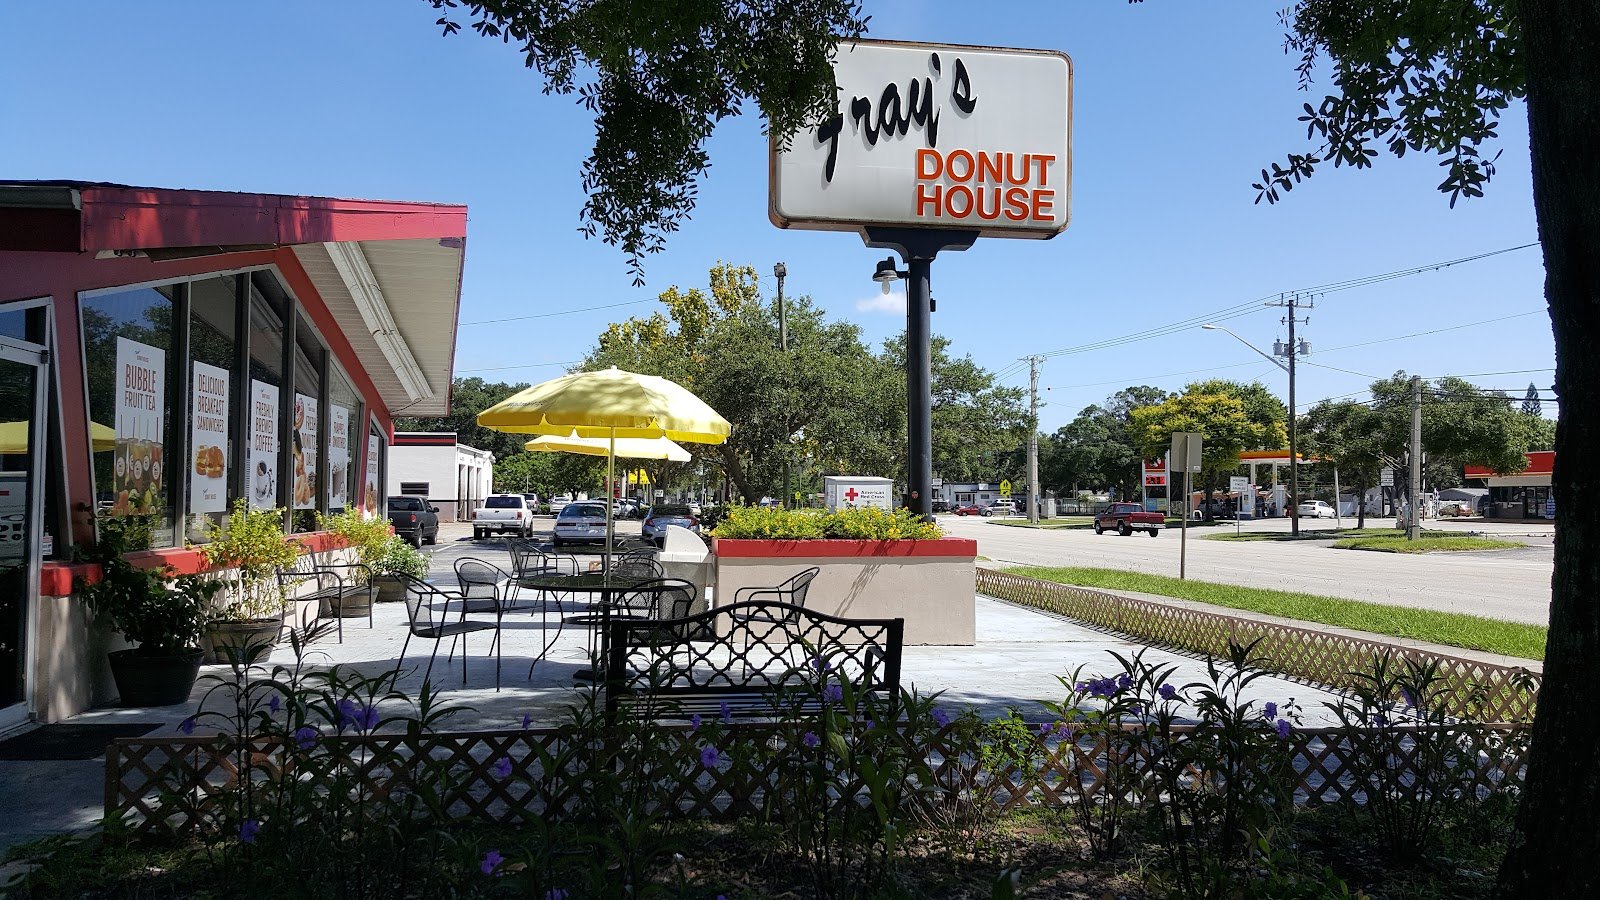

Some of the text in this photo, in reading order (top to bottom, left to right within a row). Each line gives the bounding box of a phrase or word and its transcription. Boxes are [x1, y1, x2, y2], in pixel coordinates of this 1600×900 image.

[916, 148, 1056, 187] DONUT
[916, 183, 1055, 222] HOUSE
[125, 363, 157, 394] BUBBLE
[198, 373, 225, 397] DELICIOUS
[125, 390, 156, 412] FRUIT TEA
[197, 394, 225, 417] BREAKFAST
[255, 416, 274, 435] BREWED
[255, 433, 273, 453] COFFEE
